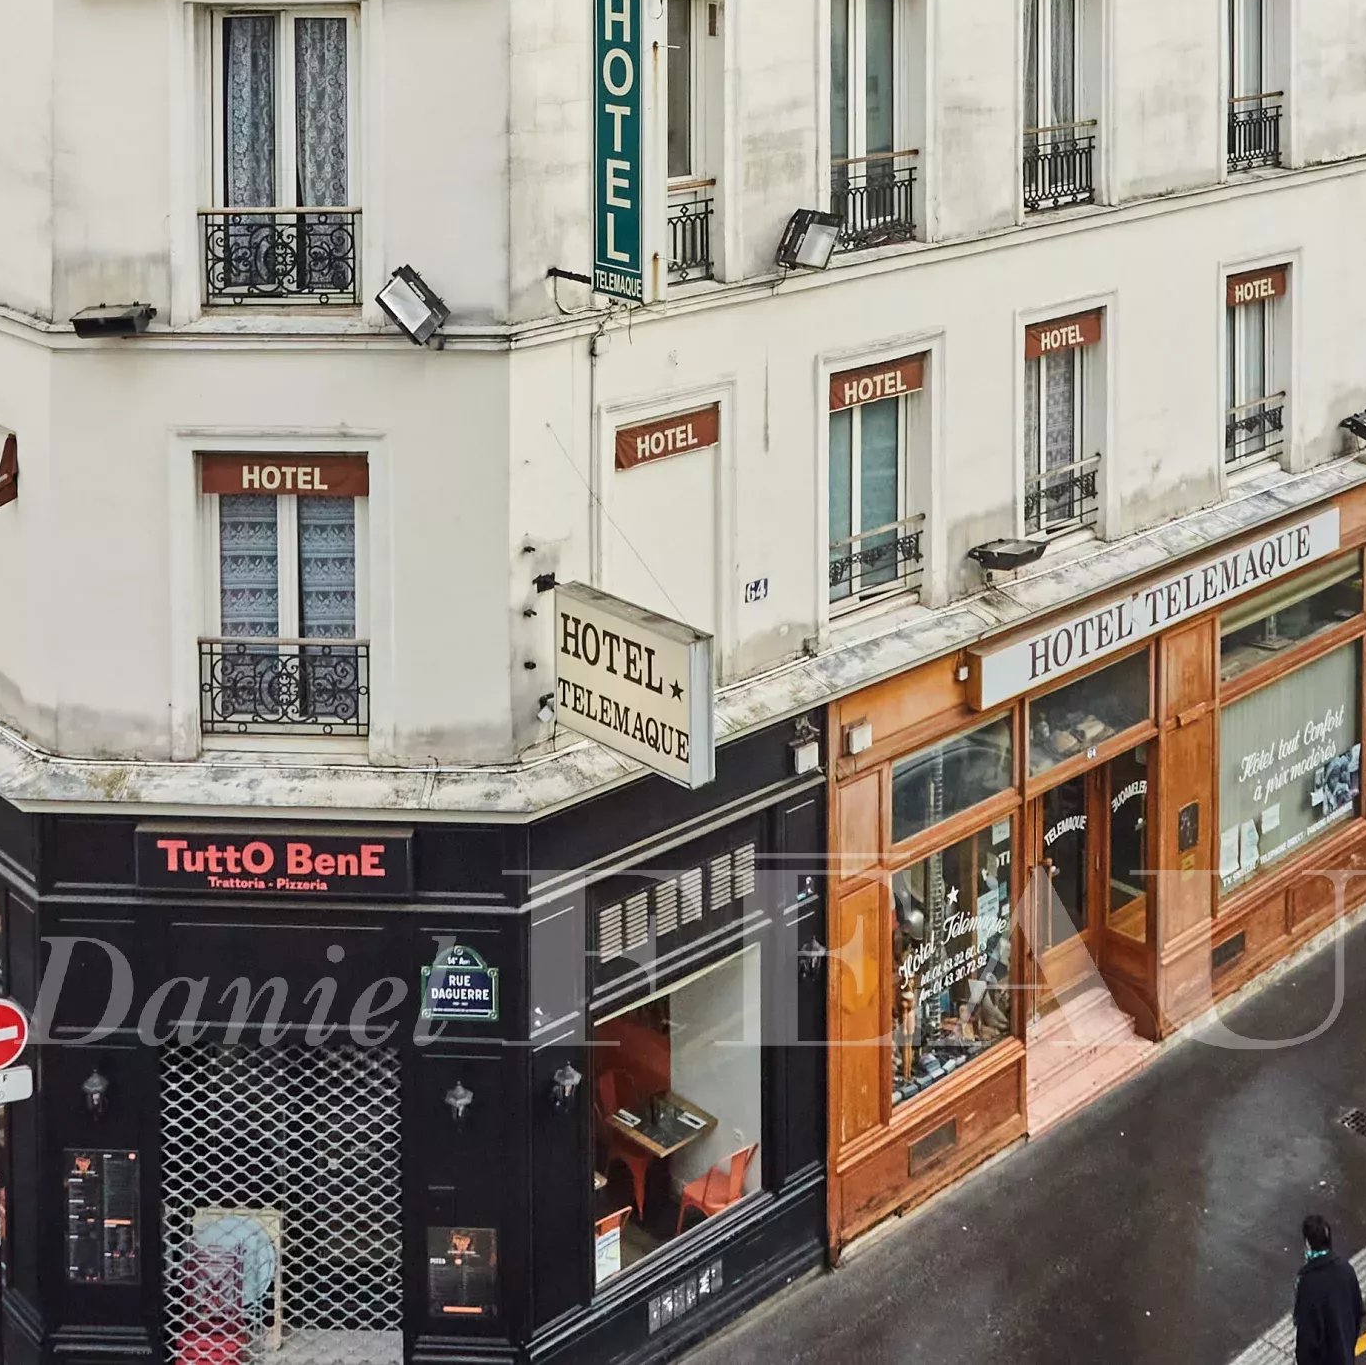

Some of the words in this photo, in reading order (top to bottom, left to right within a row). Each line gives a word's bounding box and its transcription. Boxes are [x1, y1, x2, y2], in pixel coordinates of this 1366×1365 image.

[595, 269, 642, 298] TELEMAQUE
[1235, 277, 1275, 304] HOTEL
[1040, 324, 1085, 352] HOTEL
[843, 370, 907, 405] HOTEL
[635, 422, 699, 460] HOTEL
[242, 465, 329, 490] HOTEL
[746, 580, 768, 603] 64
[1028, 602, 1134, 681] HOTEL
[1145, 524, 1312, 627] TELEMAQUE
[560, 612, 664, 695] HOTEL
[558, 677, 690, 764] TELEMAQUE
[1239, 742, 1275, 783] Hôtel
[1278, 730, 1301, 761] tout
[1303, 704, 1345, 746] Confort
[1253, 780, 1263, 803] à
[1290, 738, 1337, 781] modérés
[1044, 815, 1088, 847] TELEMAQUE
[286, 842, 386, 877] BenE
[207, 875, 266, 890] Trattoria
[276, 878, 328, 891] Pizzeria
[898, 930, 936, 990] Hôtel
[431, 988, 490, 1001] DAGUERRE
[448, 975, 471, 987] RUE
